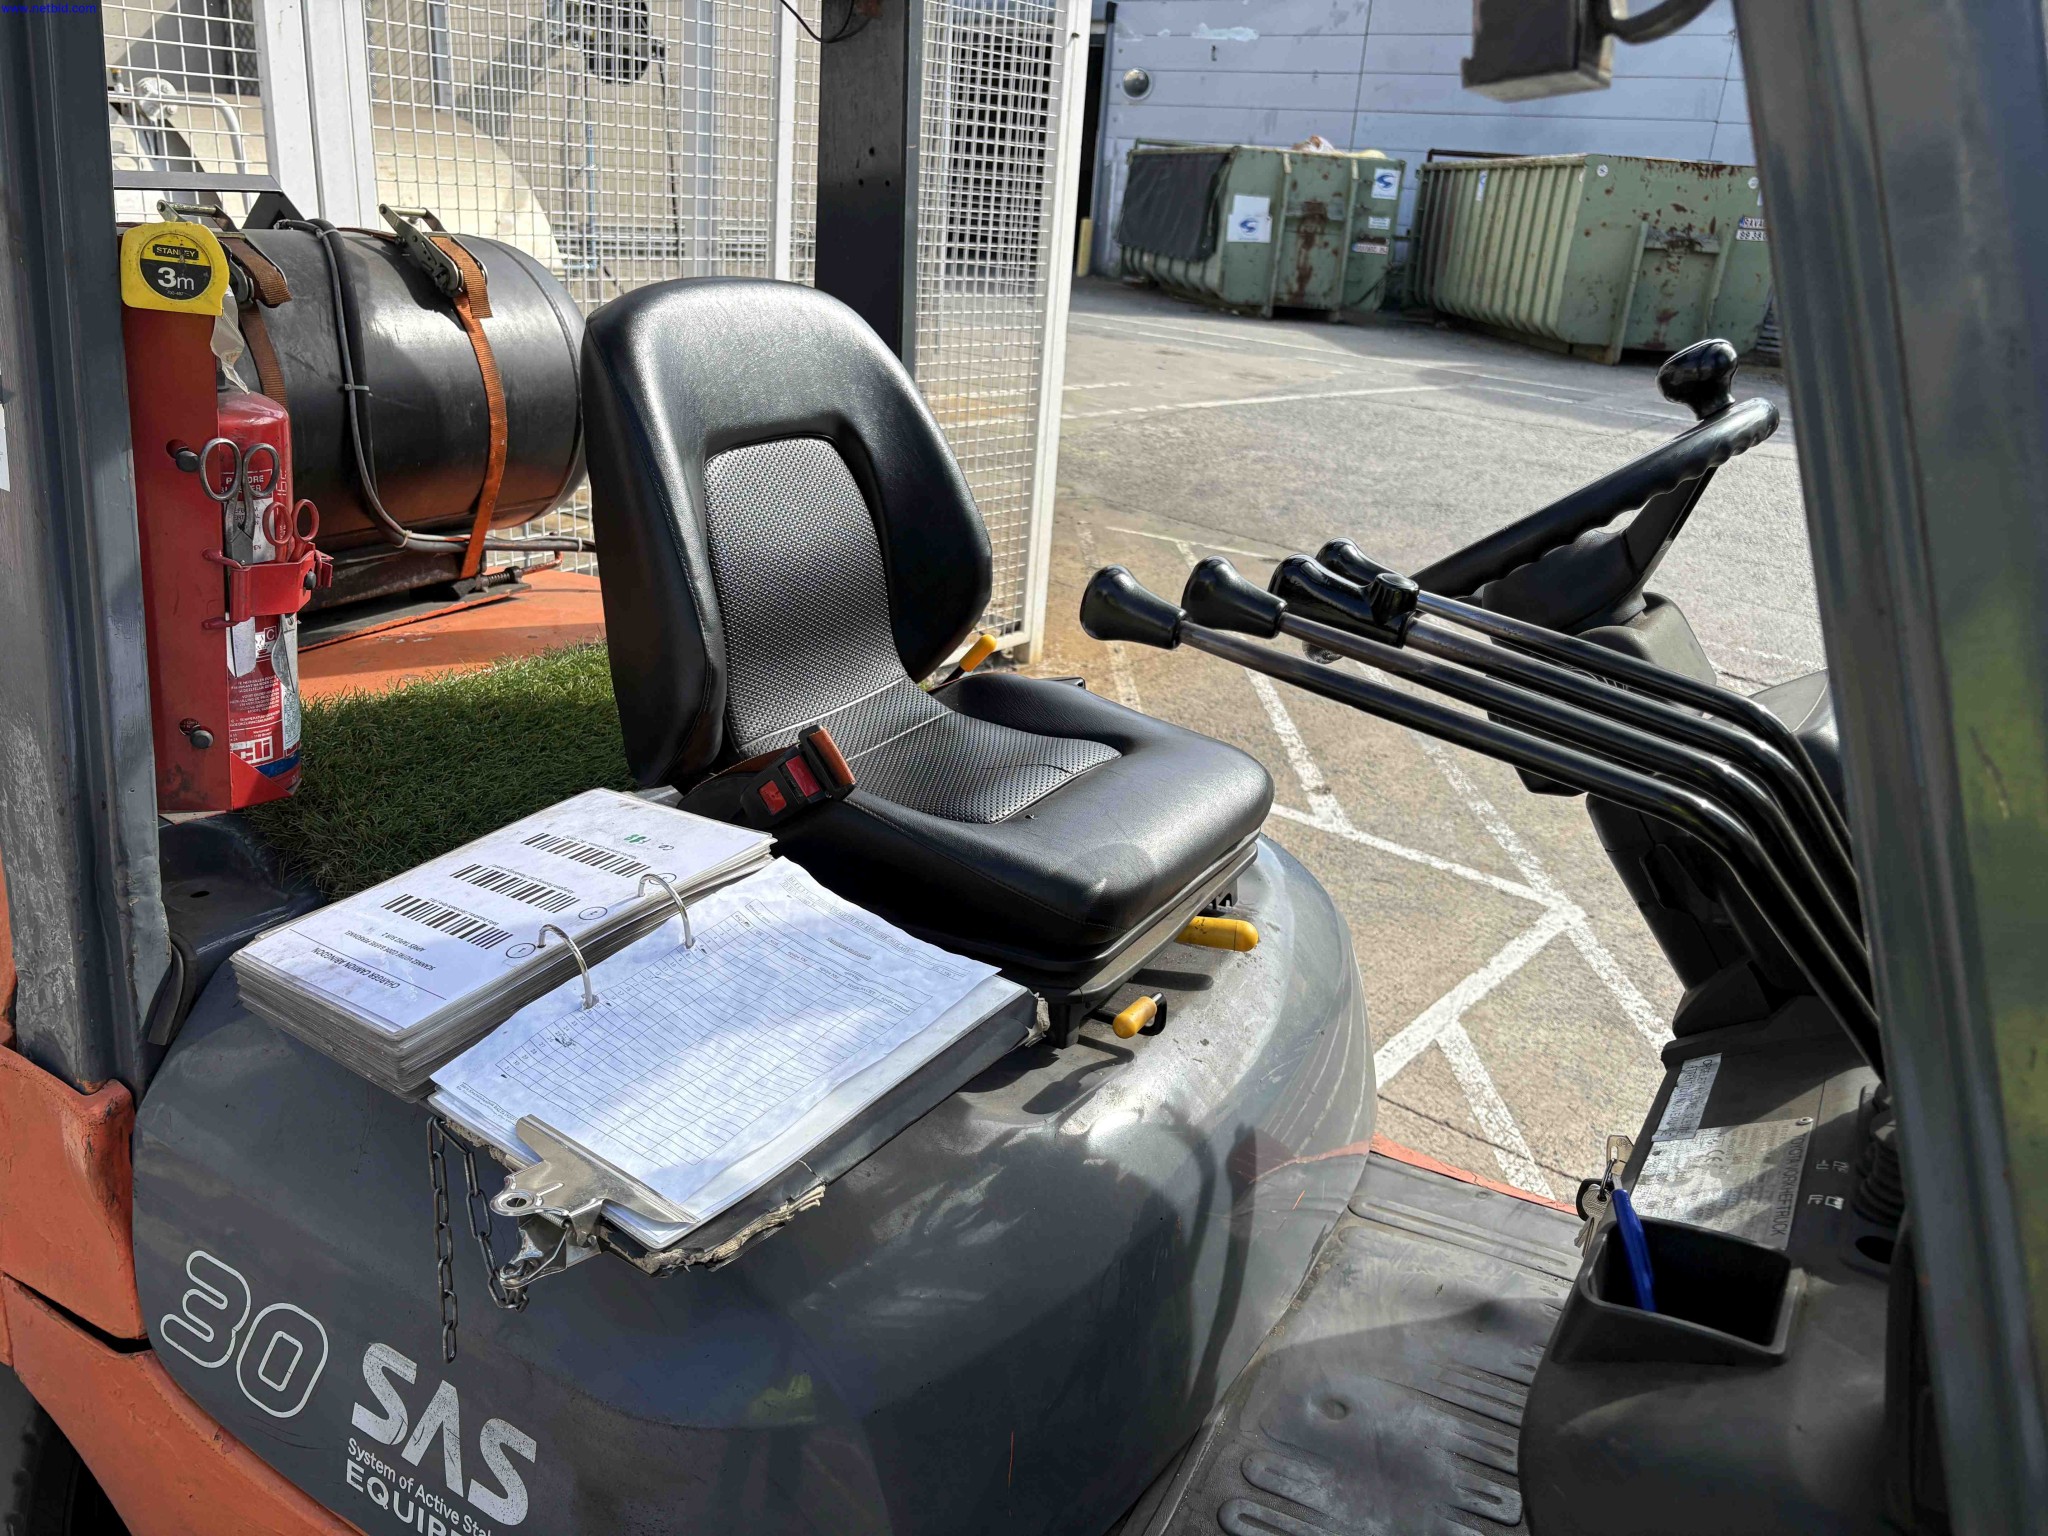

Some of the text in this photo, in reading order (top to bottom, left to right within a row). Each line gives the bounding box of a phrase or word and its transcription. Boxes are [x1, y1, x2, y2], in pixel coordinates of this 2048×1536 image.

[313, 947, 401, 989] CHARGER CAMION ABINGDON
[383, 947, 399, 955] CODE
[396, 952, 414, 961] VOTRE
[410, 958, 436, 971] SCANNEZ
[1770, 1134, 1807, 1237] TOYOTA VORKHEFTRUCK
[159, 1250, 329, 1418] 30
[351, 1342, 537, 1526] SAS
[347, 1437, 396, 1483] System
[398, 1475, 415, 1493] of
[415, 1484, 460, 1525] Active
